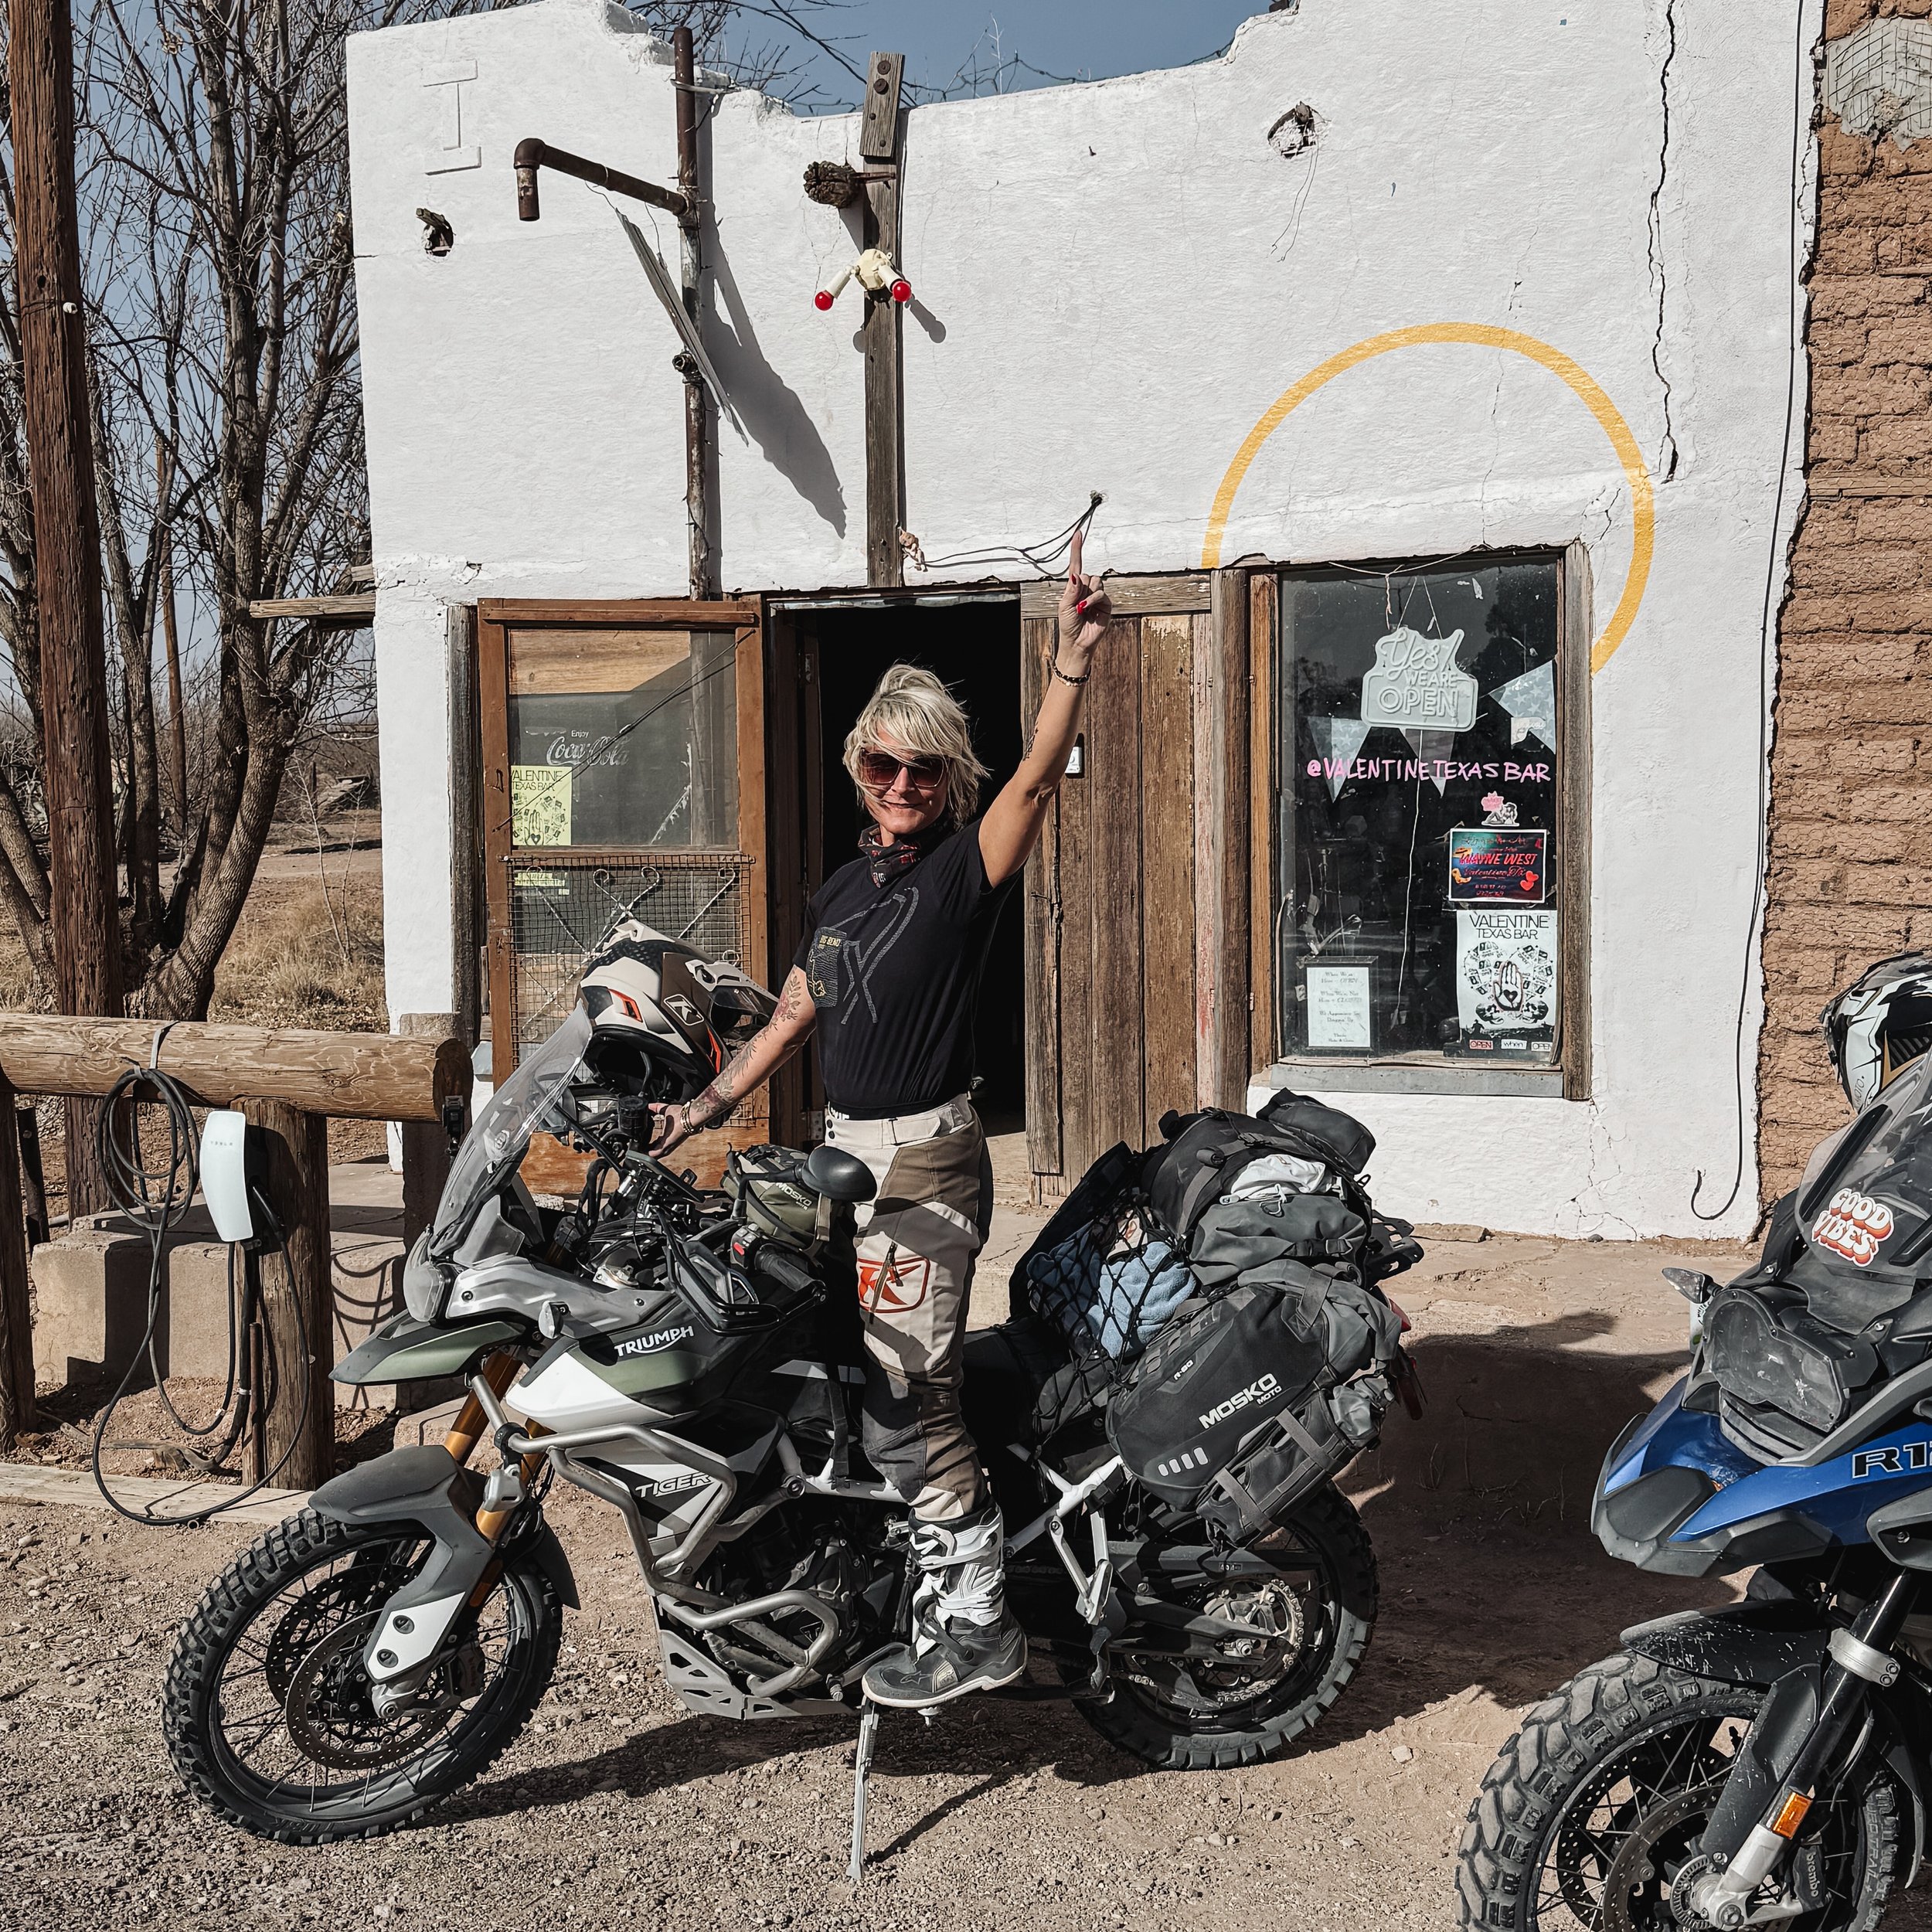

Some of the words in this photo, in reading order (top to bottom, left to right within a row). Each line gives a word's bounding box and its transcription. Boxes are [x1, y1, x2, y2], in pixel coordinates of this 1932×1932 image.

[1379, 686, 1460, 719] OPEN
[571, 730, 589, 738] Enjoy
[511, 781, 536, 791] TEXAS
[1503, 853, 1538, 865] WEST
[1469, 914, 1549, 928] VALENTINE
[1476, 928, 1512, 939] TEXAS
[1513, 929, 1539, 940] BAR
[1470, 1040, 1493, 1049] OPEN
[775, 1182, 812, 1207] MOSKO
[1829, 1188, 1892, 1240] GOOD
[1812, 1211, 1876, 1264] VIBES
[614, 1325, 695, 1357] TRIUMPH
[1199, 1372, 1277, 1429] MOSKO
[1257, 1385, 1282, 1405] MOTO
[1852, 1441, 1932, 1479] R1
[634, 1474, 710, 1498] TIGER
[1805, 1851, 1821, 1898] brembo
